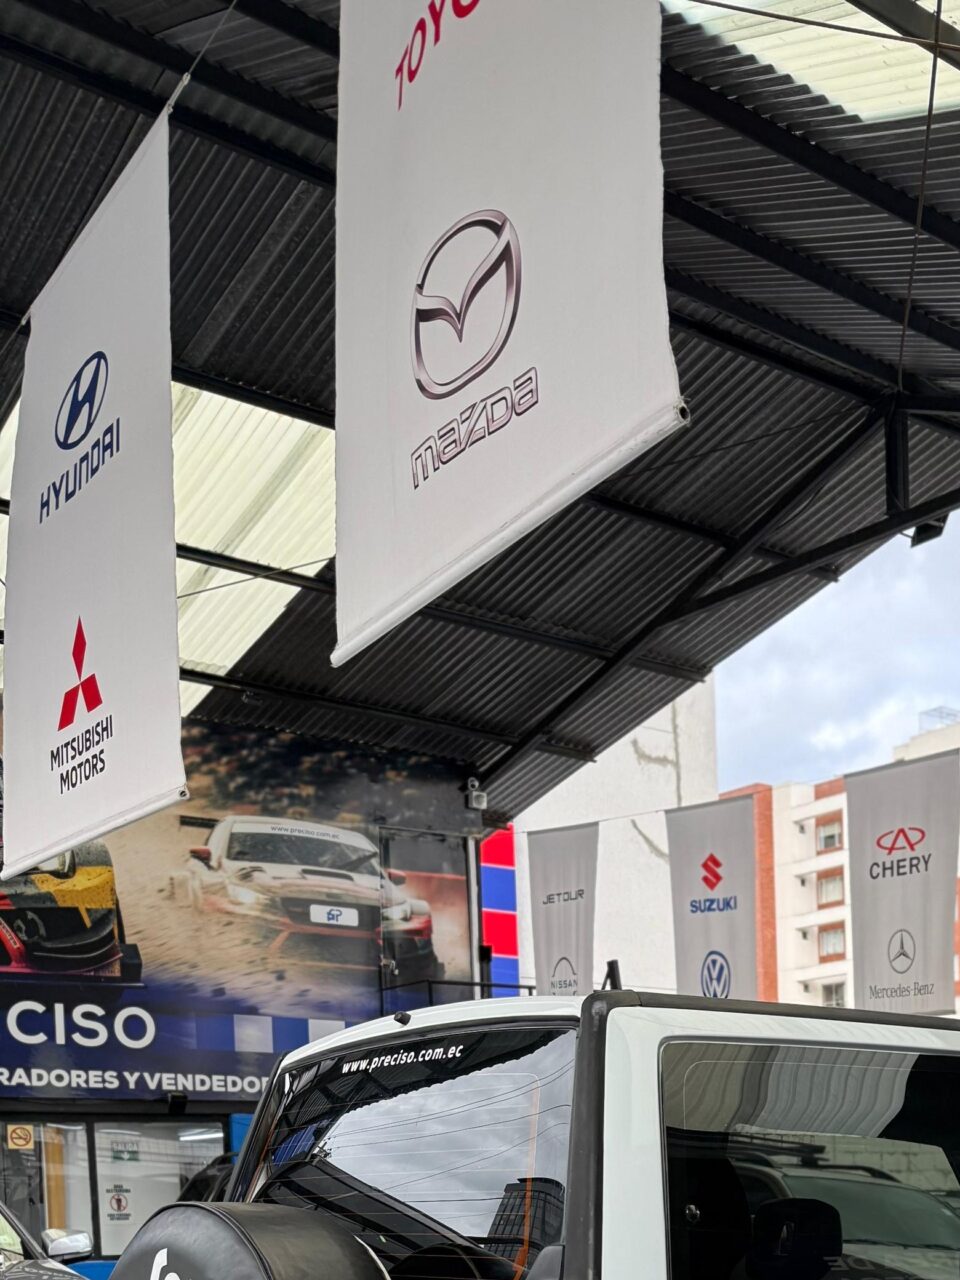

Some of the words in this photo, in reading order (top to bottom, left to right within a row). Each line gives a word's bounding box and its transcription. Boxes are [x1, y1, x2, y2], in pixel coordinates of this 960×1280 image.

[395, 0, 481, 111] TOY
[39, 417, 120, 524] HYUNDAI
[50, 714, 113, 771] MITSUBISHI
[60, 748, 105, 794] MOTORS
[869, 853, 932, 880] CHERY
[542, 889, 584, 905] JETOUR
[690, 896, 737, 914] SUZUKI
[551, 978, 578, 989] NISSAN
[869, 981, 935, 1000] Mercedes-Benz
[6, 1000, 156, 1049] CISO
[342, 1045, 464, 1074] www.preciso.com.ec
[123, 1072, 146, 1089] Y
